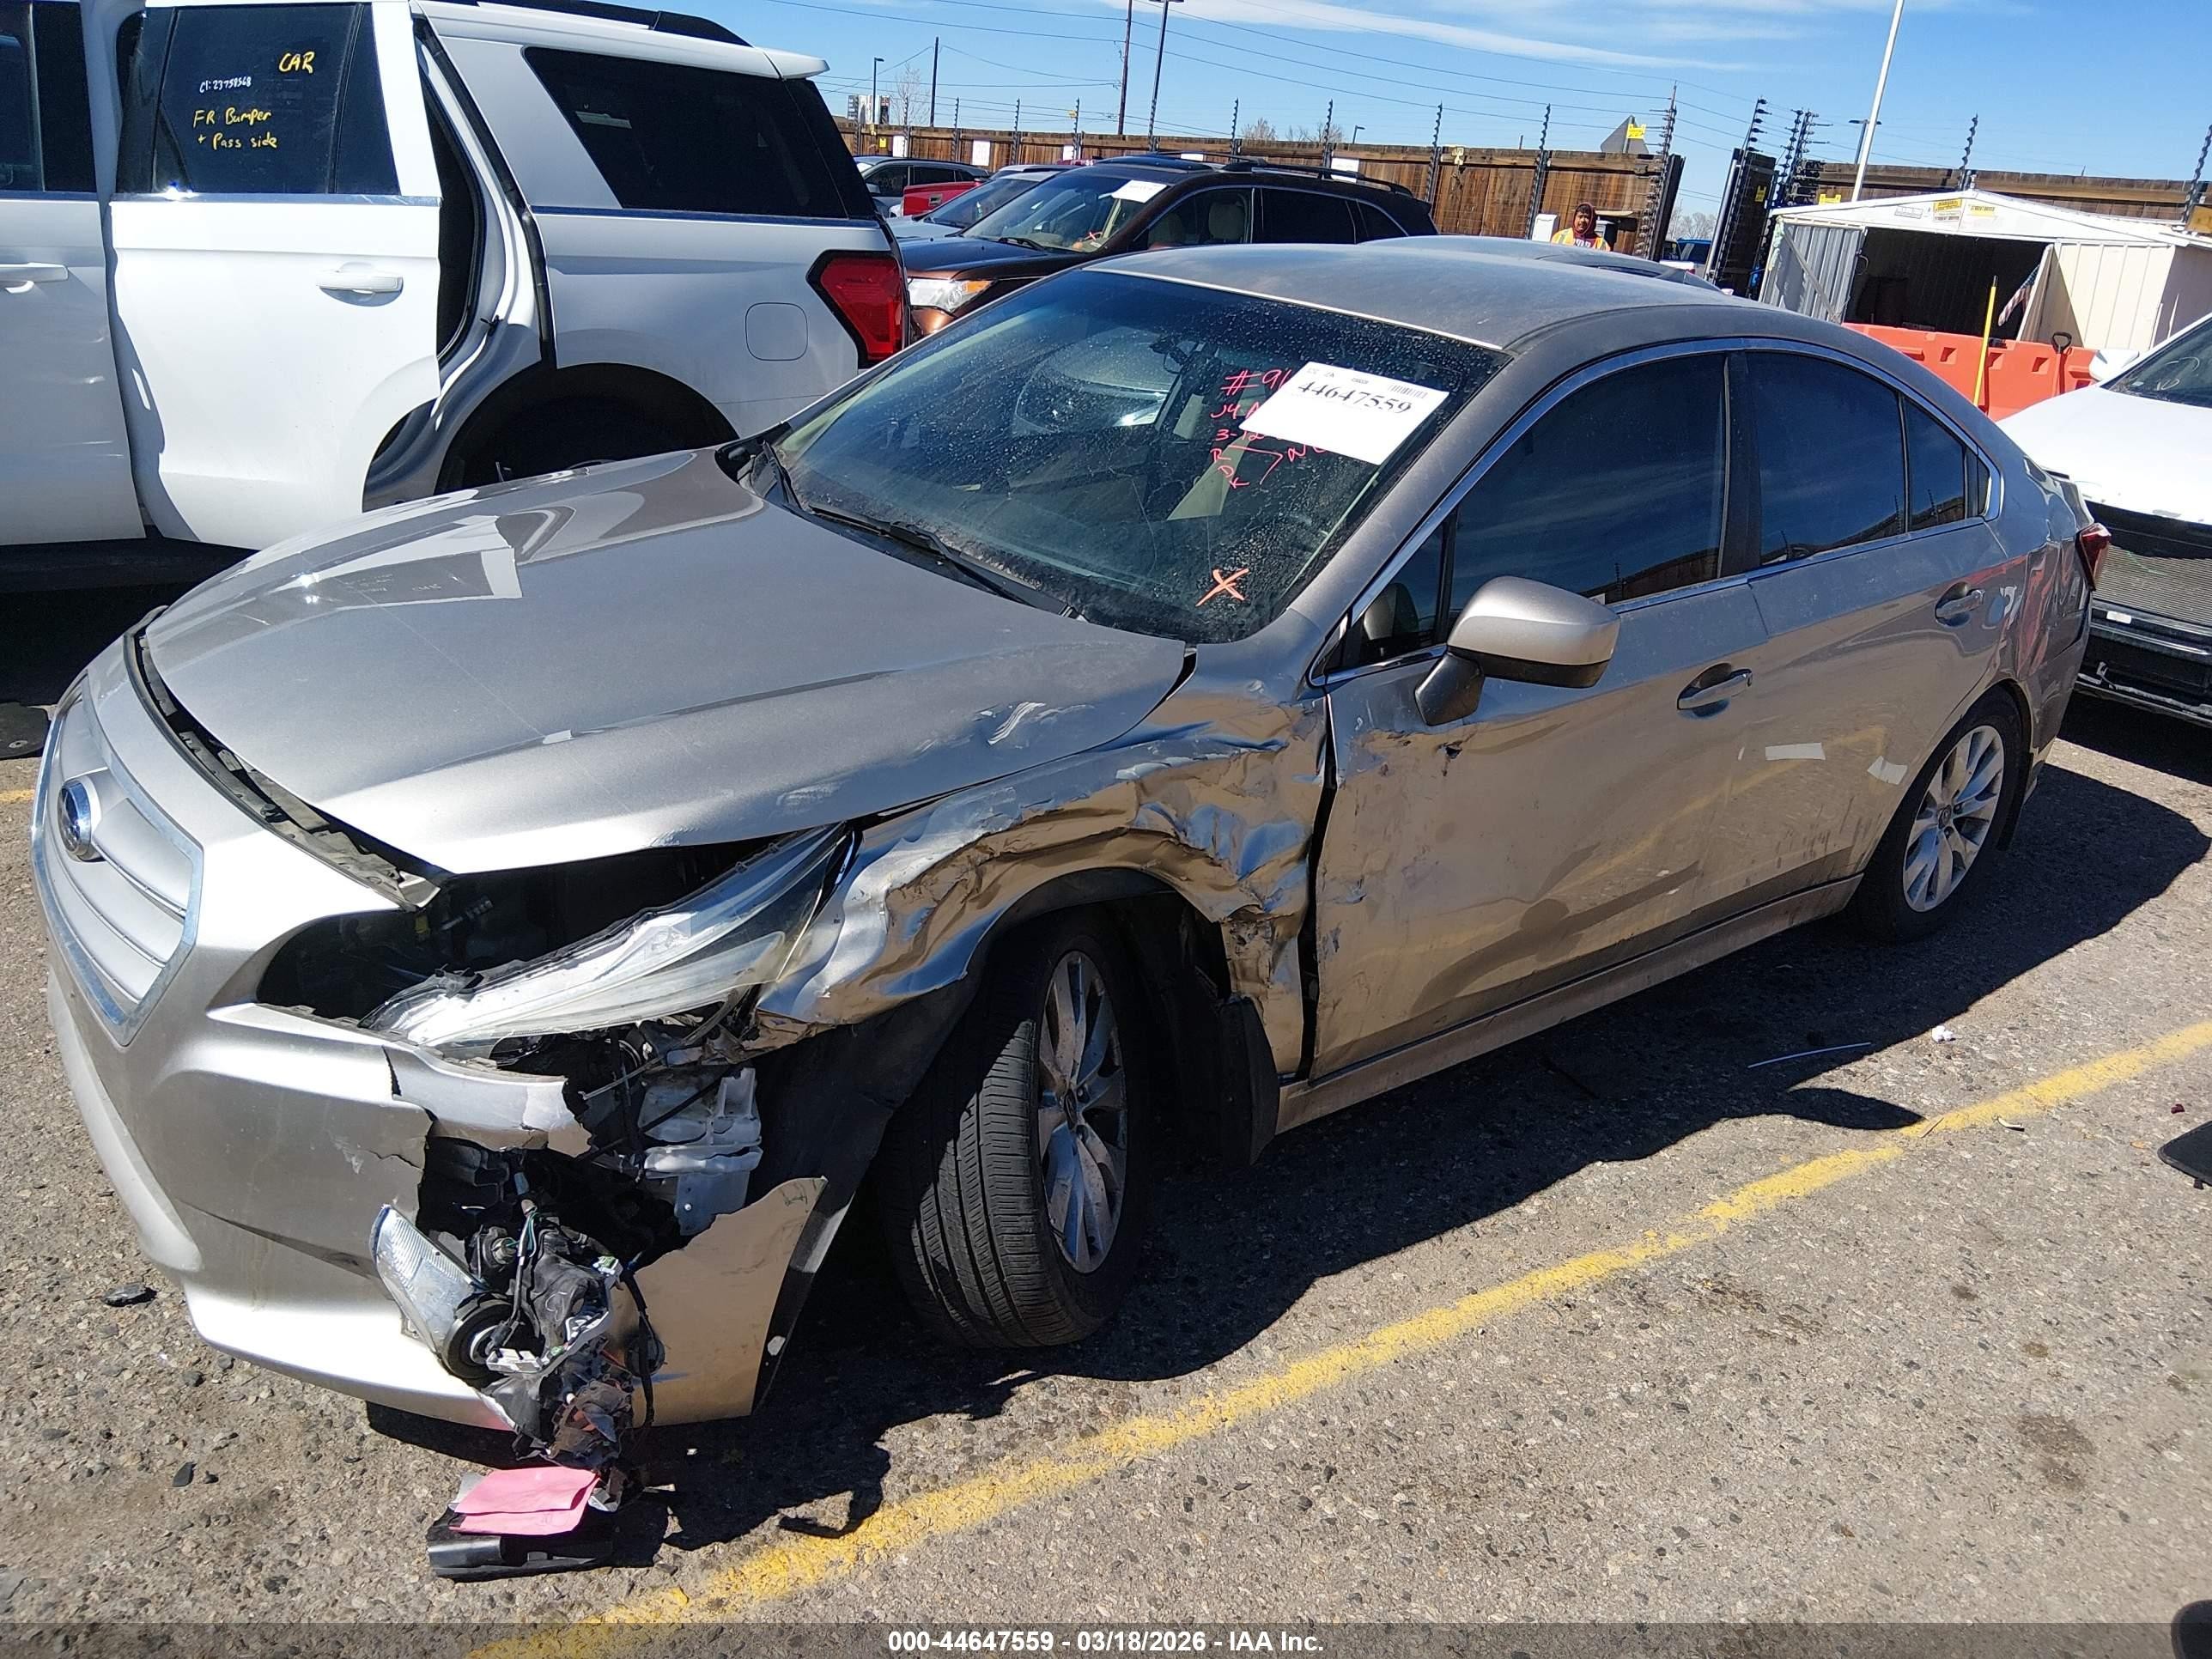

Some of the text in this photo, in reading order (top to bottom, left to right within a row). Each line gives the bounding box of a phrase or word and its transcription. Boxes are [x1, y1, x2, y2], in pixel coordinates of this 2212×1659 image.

[278, 51, 315, 74] CAR
[193, 110, 216, 128] FR
[212, 132, 242, 150] Pass
[250, 131, 278, 149] side
[1297, 380, 1413, 414] 44647559
